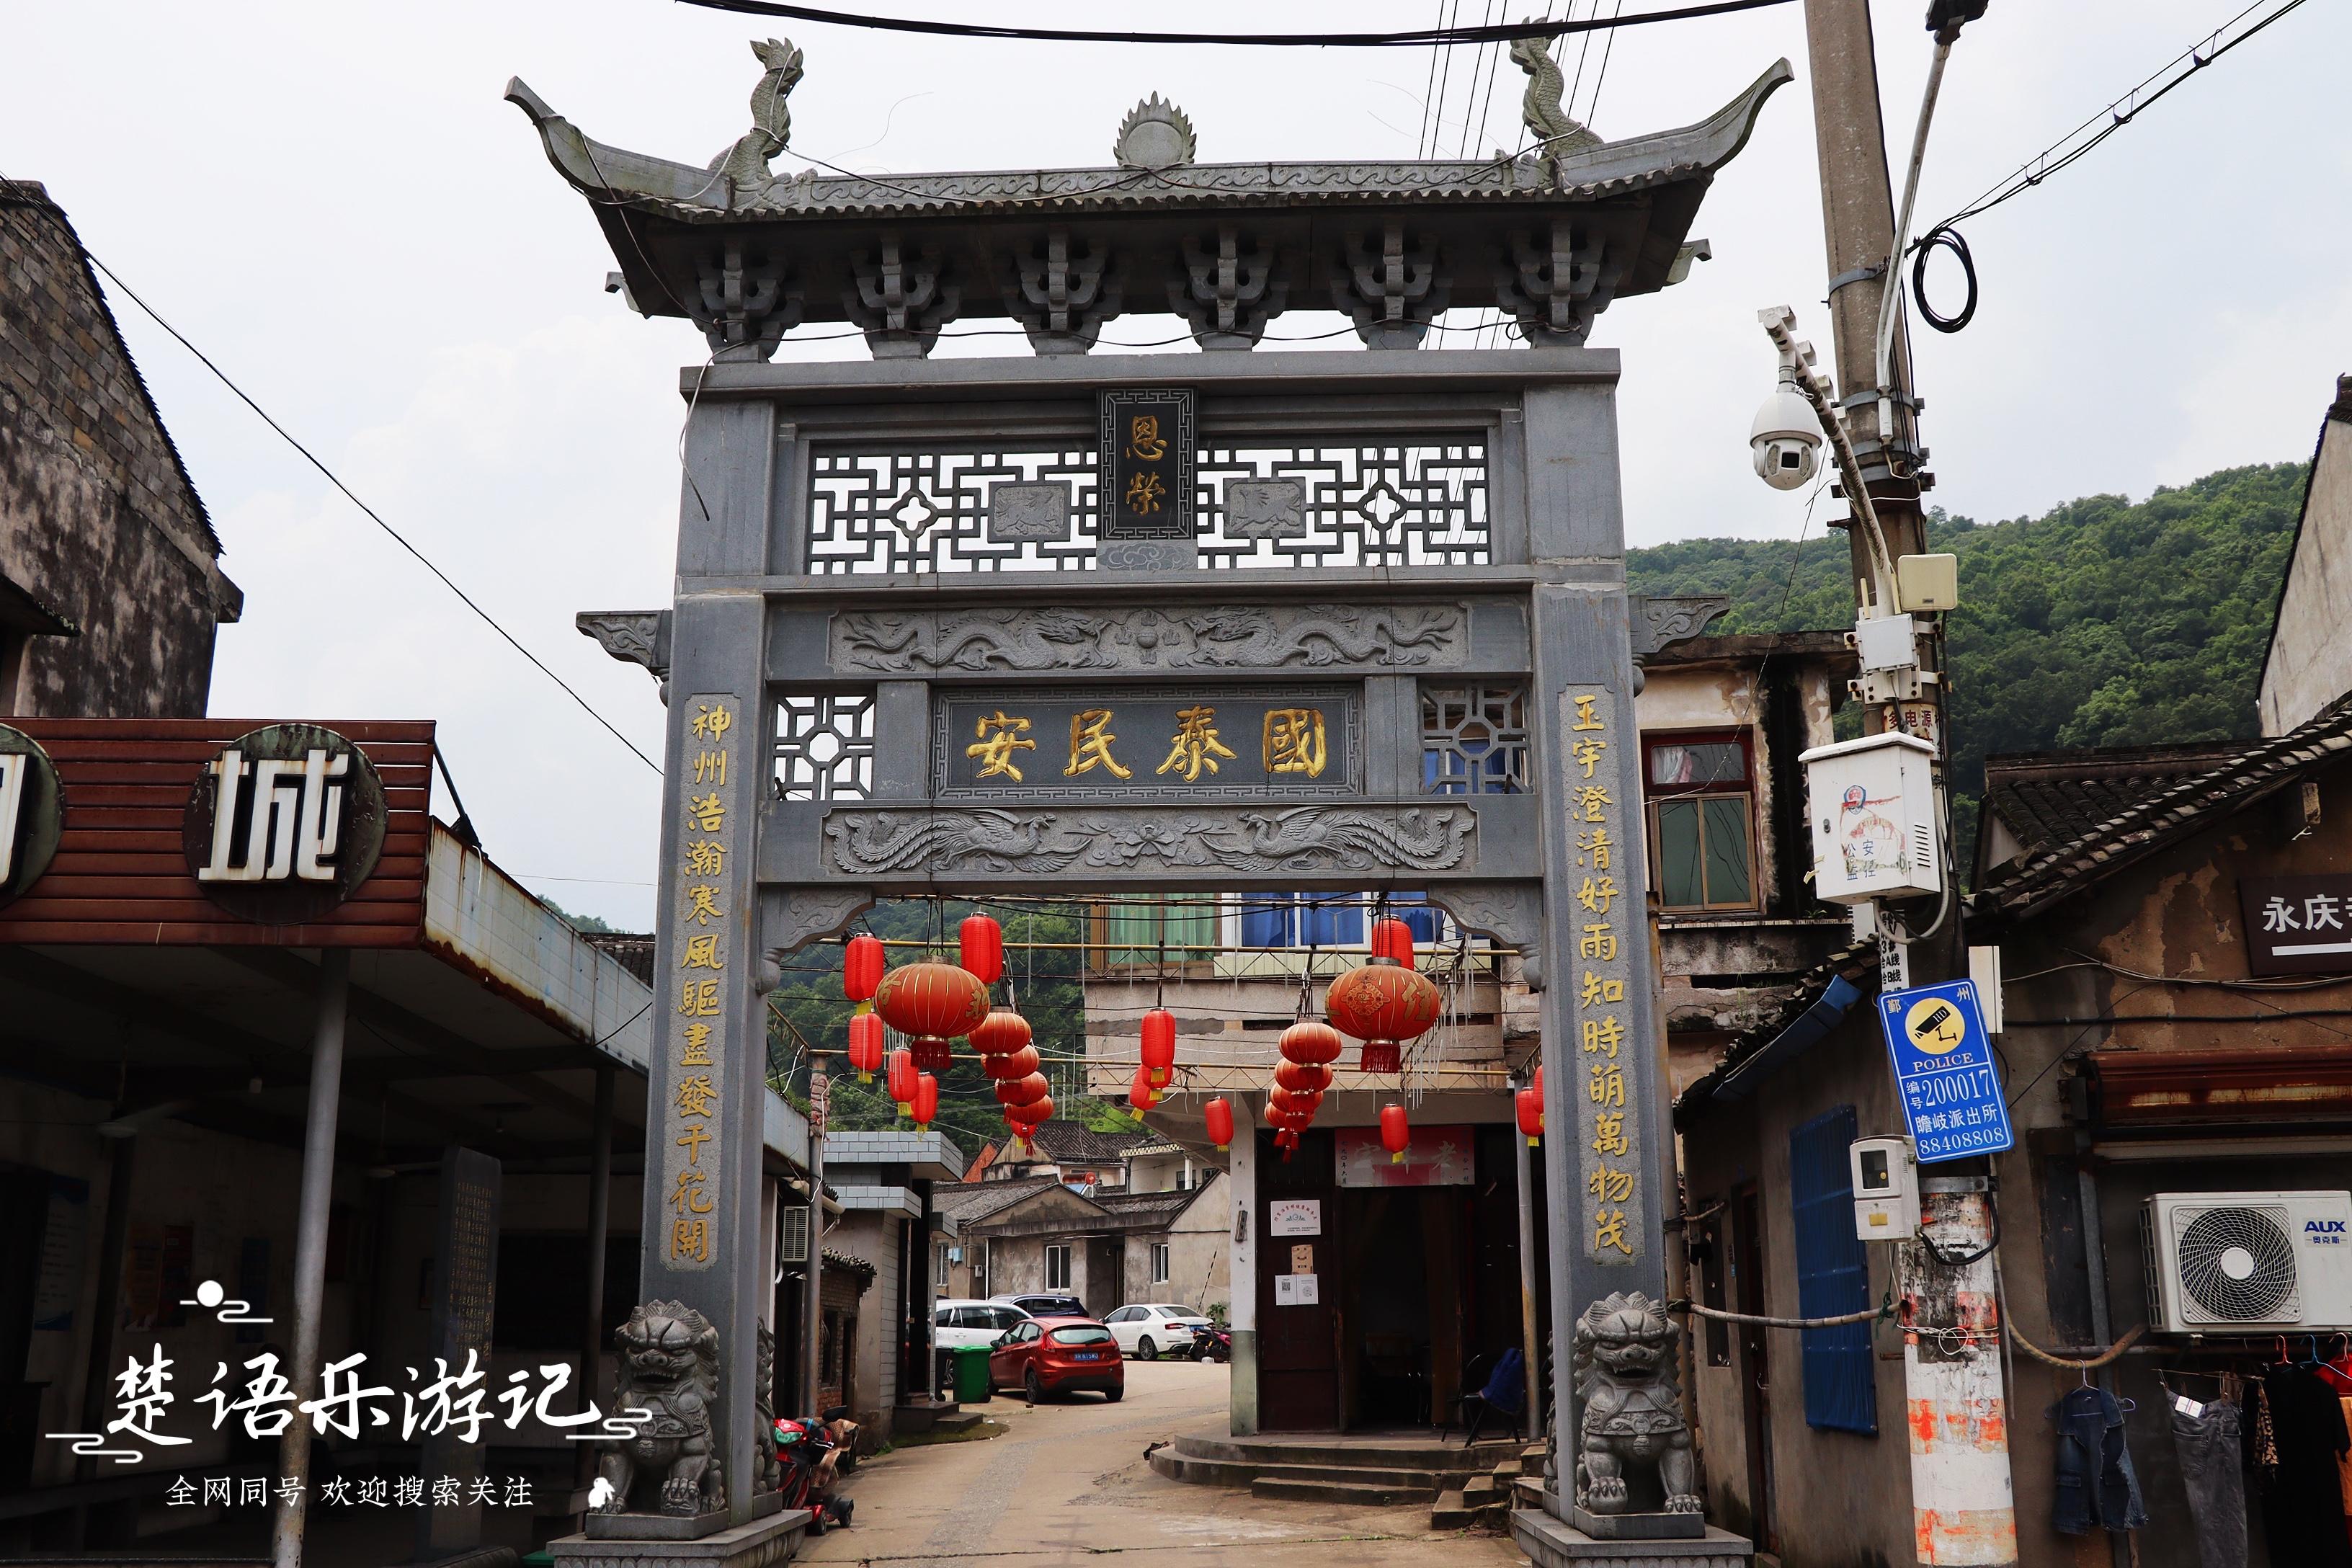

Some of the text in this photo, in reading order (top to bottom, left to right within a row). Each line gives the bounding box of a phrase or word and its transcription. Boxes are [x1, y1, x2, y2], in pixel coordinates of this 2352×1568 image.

[2262, 894, 2352, 933] 永庆
[1933, 1009, 1948, 1023] HD
[1912, 1052, 1974, 1073] POLICE
[1906, 1080, 1923, 1110] 编号
[1921, 1069, 1990, 1108] 200017
[1915, 1102, 1998, 1134] 瞻岐派出所
[1919, 1127, 2005, 1155] 88408808
[2304, 1221, 2347, 1233] AUX
[2312, 1235, 2340, 1244] 奥克斯
